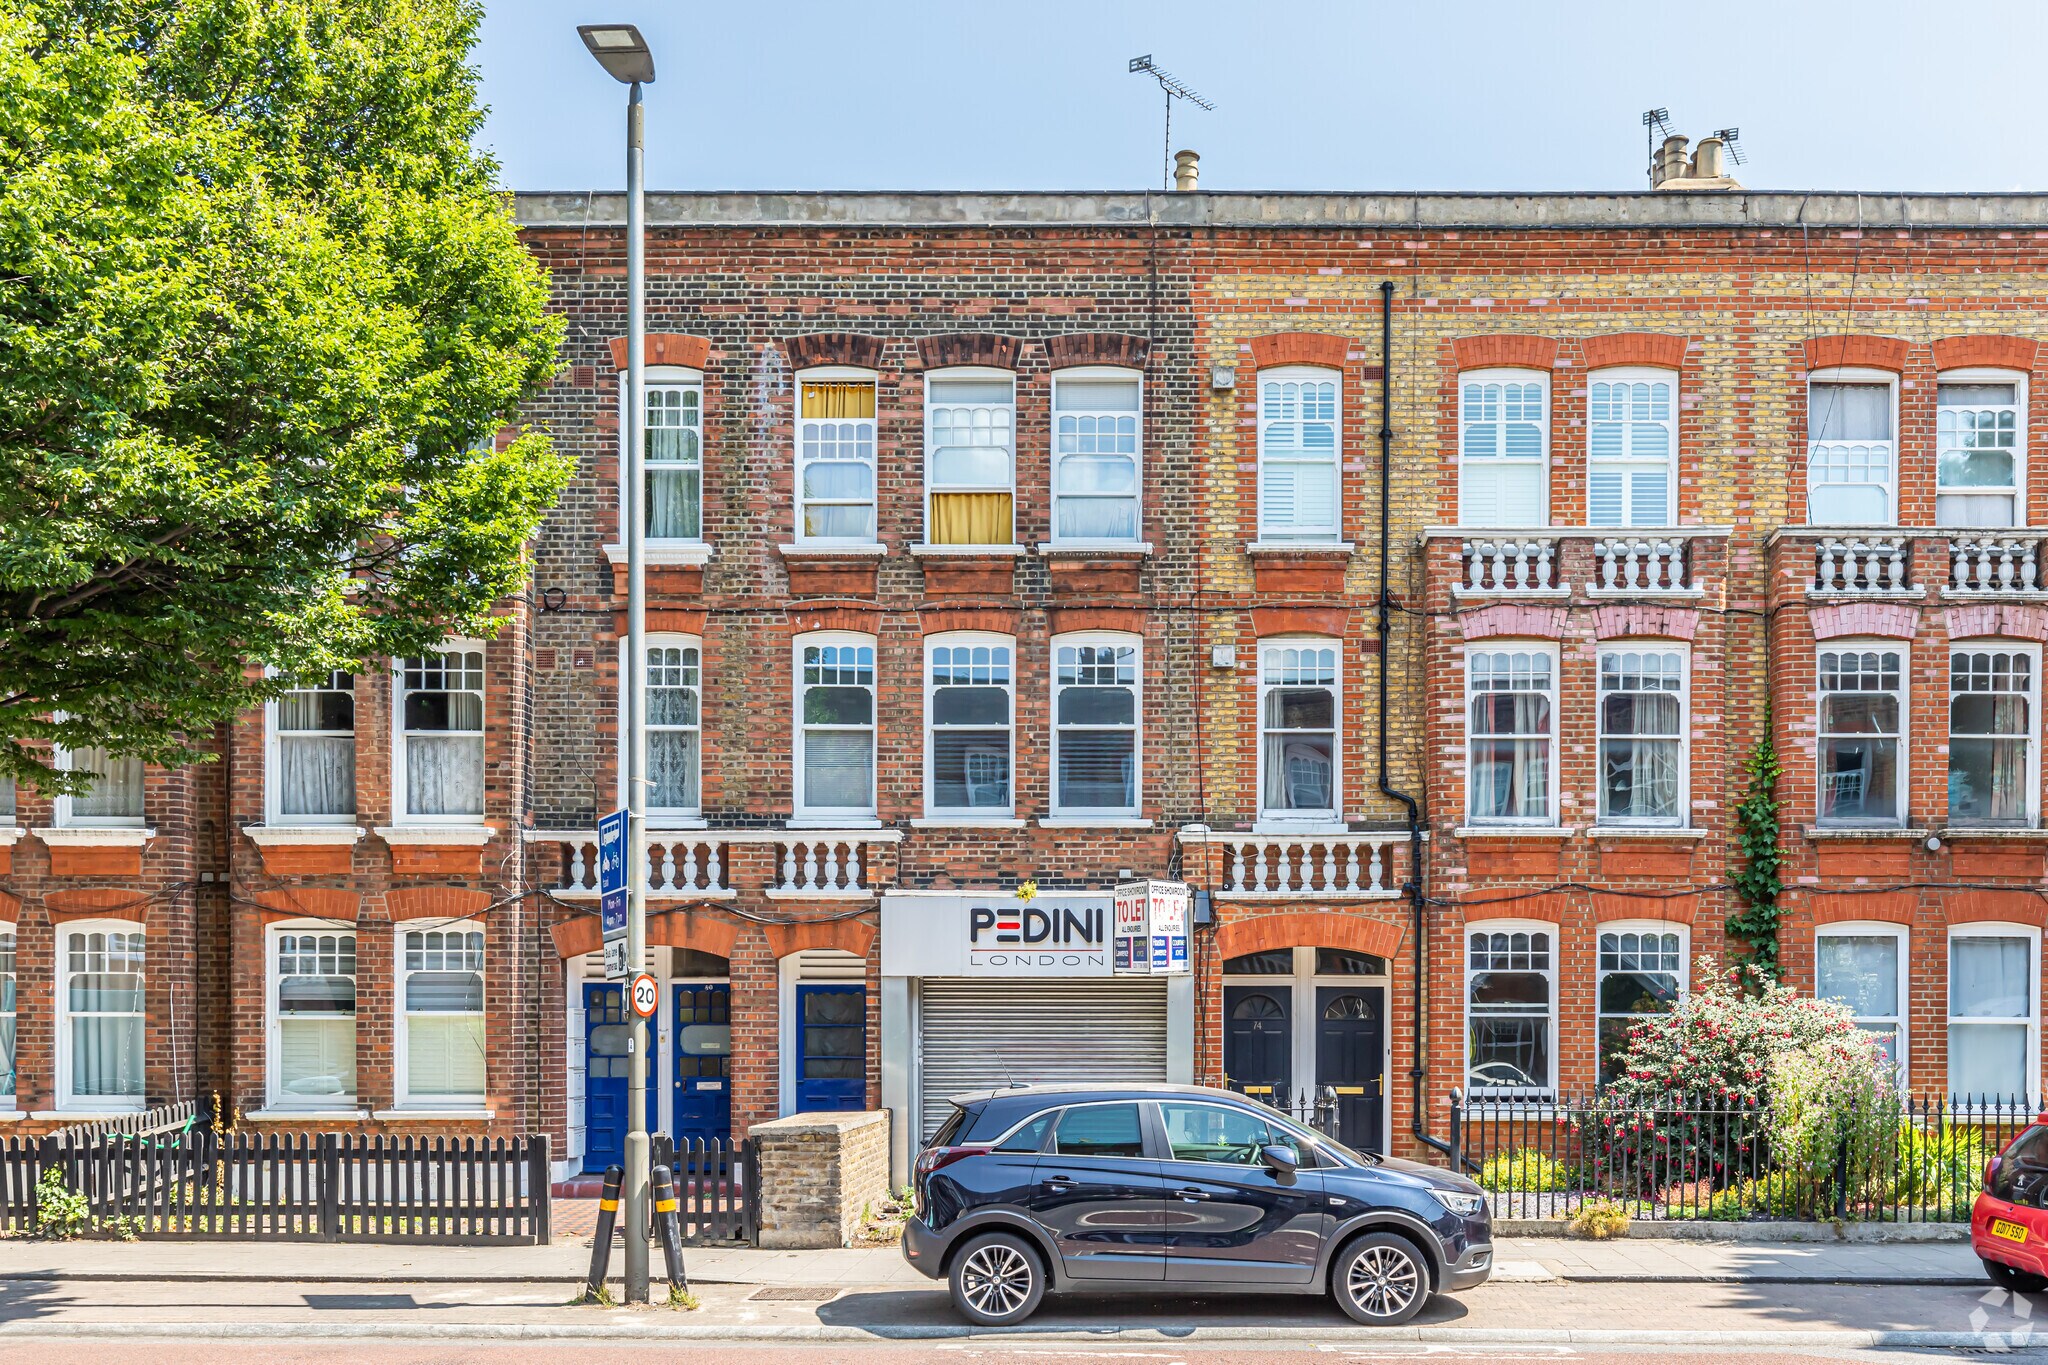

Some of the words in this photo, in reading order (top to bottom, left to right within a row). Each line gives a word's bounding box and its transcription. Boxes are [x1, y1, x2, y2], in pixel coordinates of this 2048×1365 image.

[1117, 900, 1128, 922] TO
[1131, 898, 1146, 921] LET
[970, 908, 1103, 943] PEDINI
[971, 955, 1103, 966] LONDON
[636, 986, 654, 1004] 20
[1253, 1021, 1262, 1030] 74
